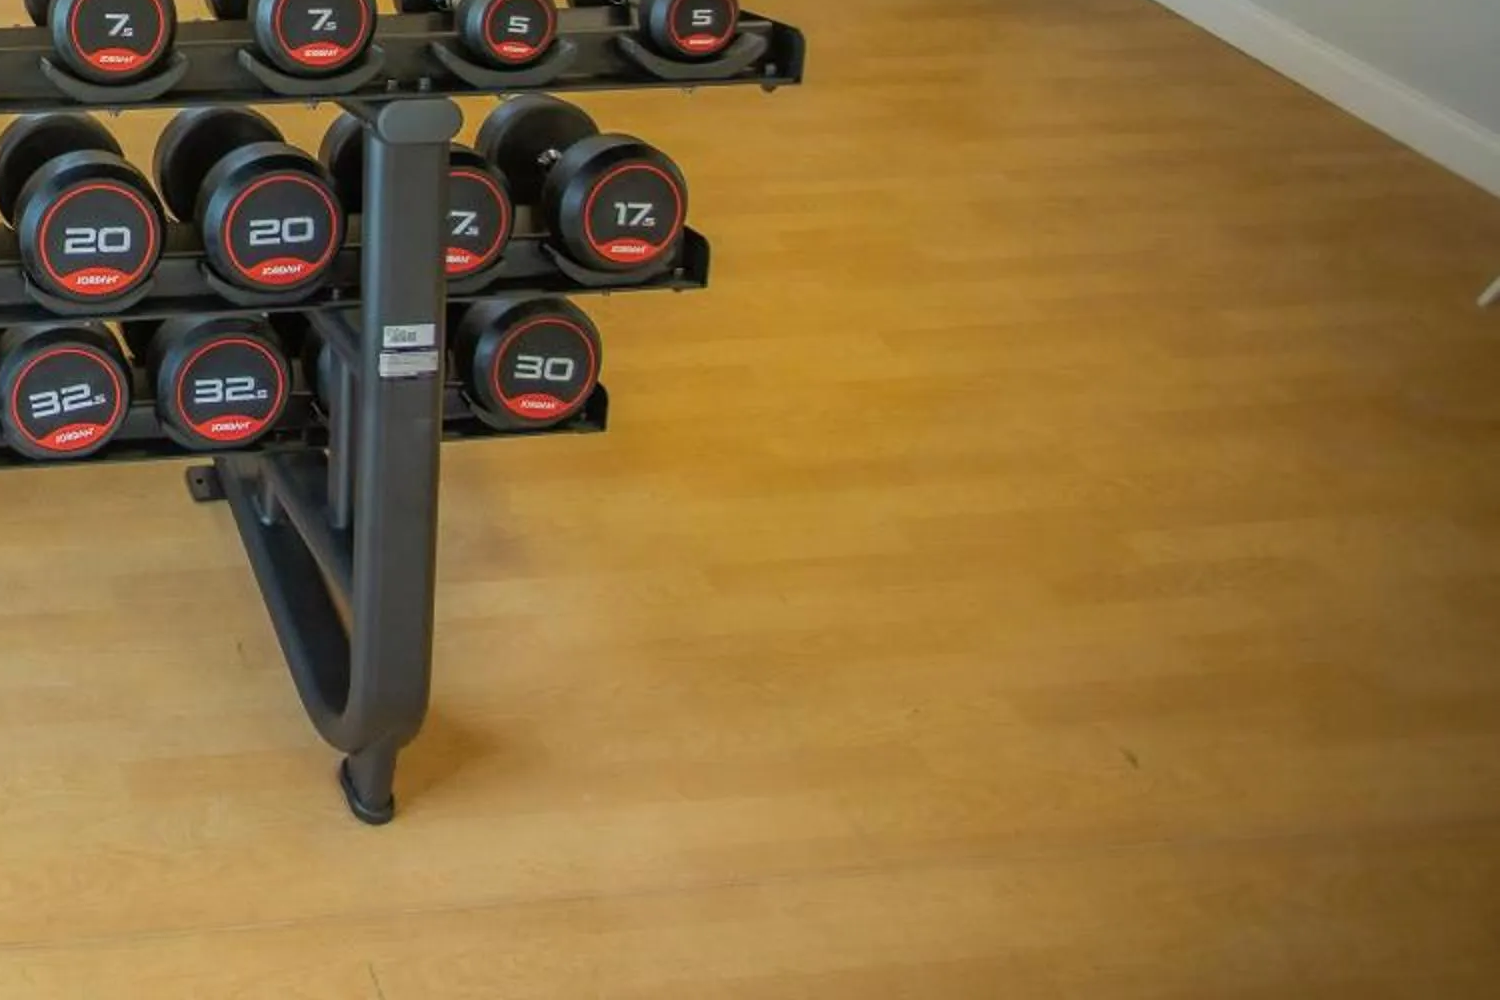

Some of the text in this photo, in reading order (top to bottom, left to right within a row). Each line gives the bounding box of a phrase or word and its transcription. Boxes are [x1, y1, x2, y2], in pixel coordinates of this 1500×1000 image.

[507, 15, 531, 34] 5
[691, 9, 713, 26] 5
[249, 216, 315, 246] 20
[64, 226, 131, 254] 20
[262, 264, 301, 275] JORDAN
[76, 275, 119, 285] JORDAN
[514, 355, 575, 381] 30
[520, 400, 556, 409] JORDAN
[55, 427, 95, 443] JORDAN
[211, 421, 251, 433] JORDAN
